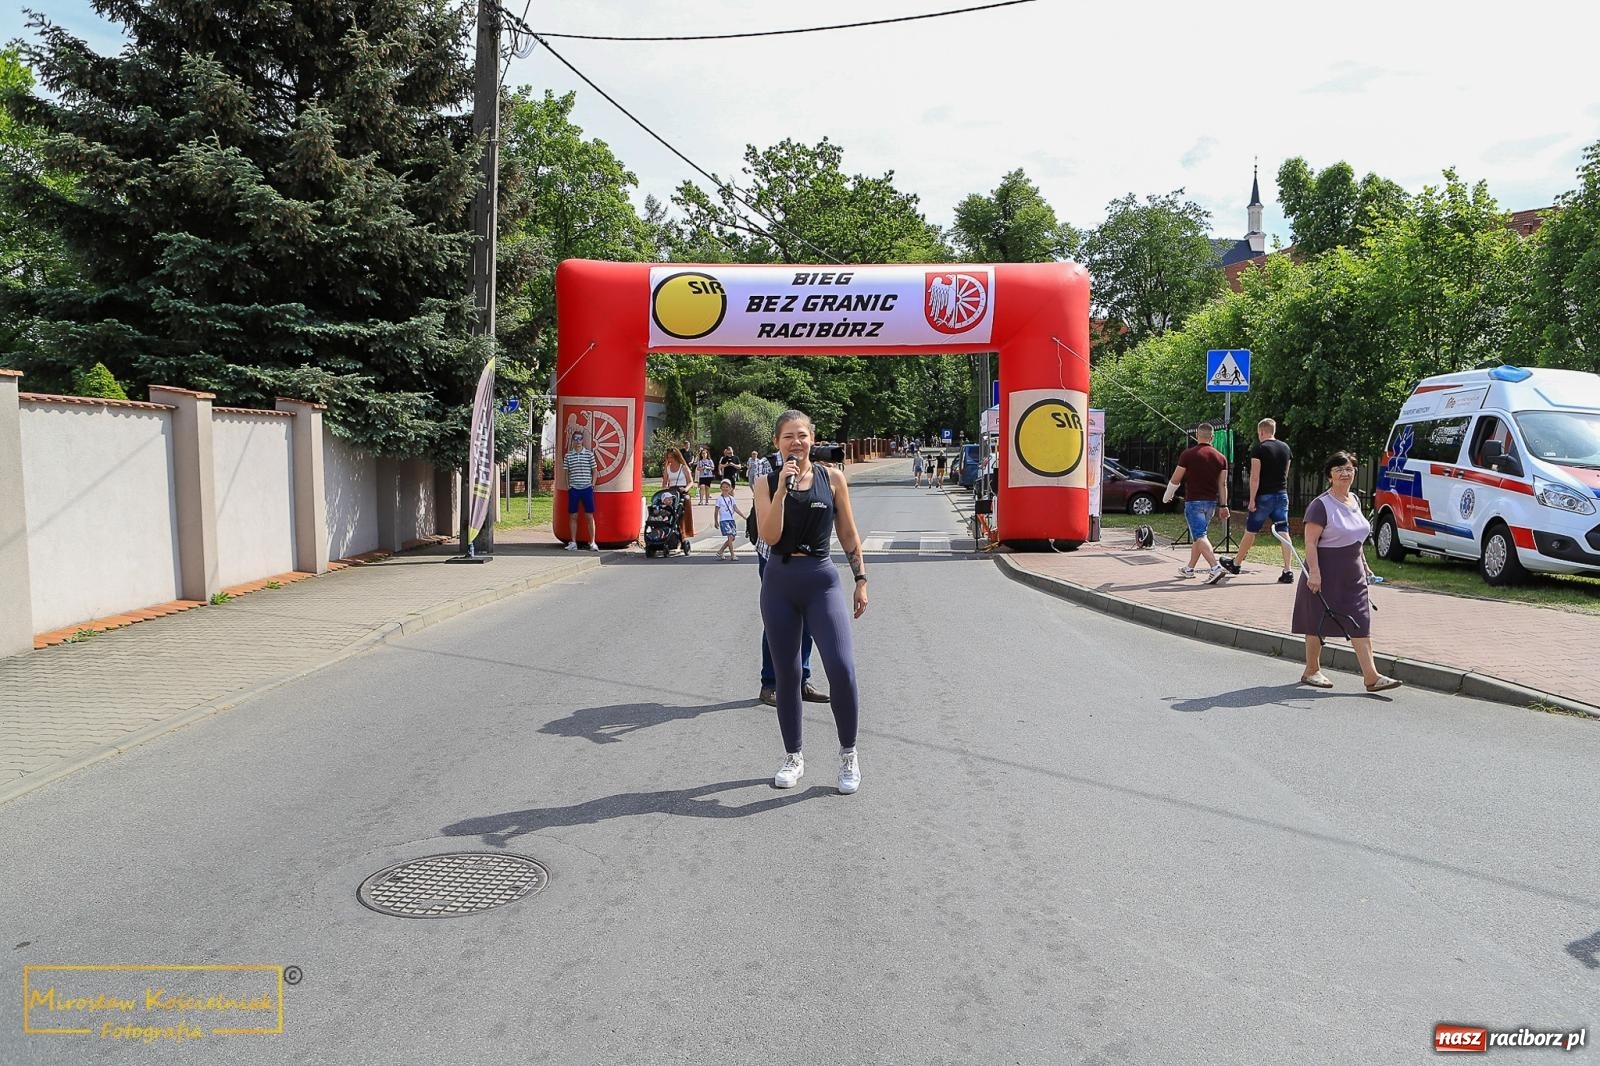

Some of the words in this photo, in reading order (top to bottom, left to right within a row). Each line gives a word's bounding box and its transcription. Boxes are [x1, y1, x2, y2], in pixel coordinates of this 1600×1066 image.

[791, 272, 854, 286] BIEG
[745, 295, 800, 313] BEZ
[801, 294, 899, 312] GRANIC
[757, 317, 885, 339] RACIBÓRZ
[944, 430, 951, 438] P
